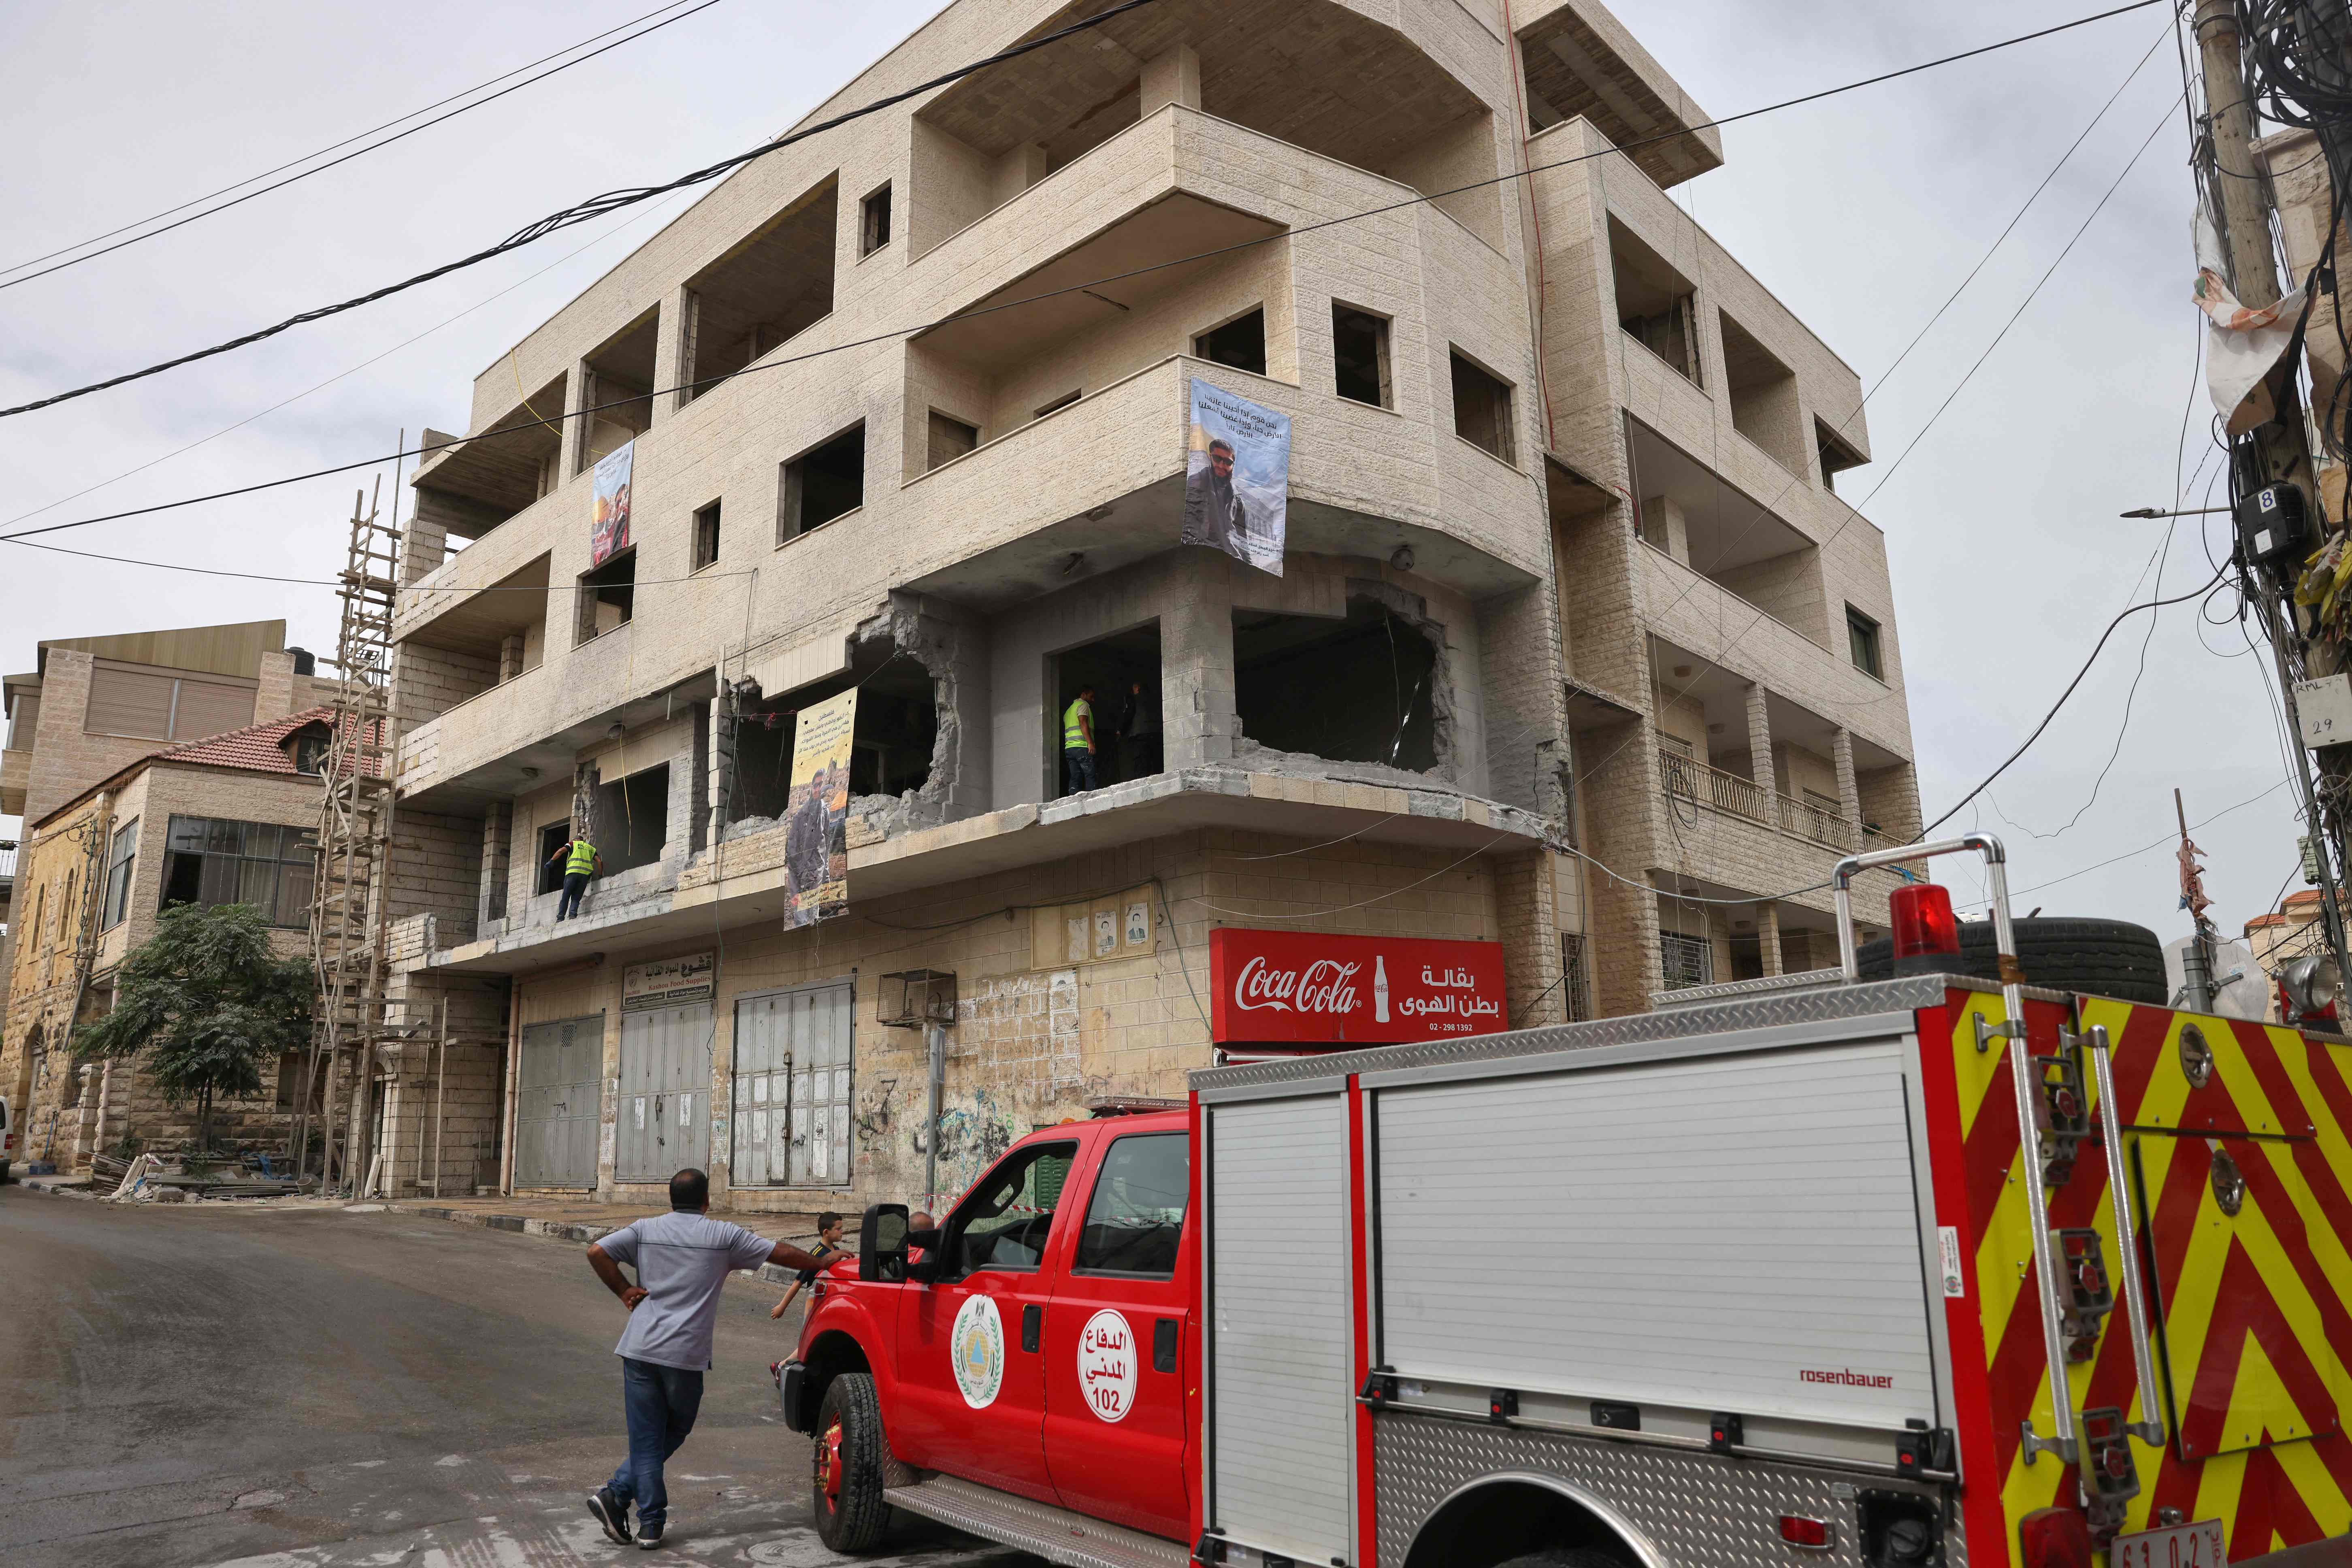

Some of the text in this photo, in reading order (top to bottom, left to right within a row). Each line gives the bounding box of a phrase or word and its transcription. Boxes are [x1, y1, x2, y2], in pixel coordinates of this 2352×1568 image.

[1205, 394, 1221, 406] عانقنا
[1224, 402, 1239, 413] أحببنا
[1221, 411, 1238, 422] غضبنا
[1239, 418, 1251, 429] وإذا
[1251, 415, 1265, 423] قوم
[1236, 429, 1253, 438] الأرض
[2262, 492, 2273, 508] 8
[818, 709, 835, 721] فلسطين
[2313, 719, 2332, 735] 29
[686, 976, 711, 985] Supplies
[1421, 965, 1474, 992] بقالة
[1399, 995, 1499, 1018] بطن الهوى
[1086, 1328, 1127, 1353] الدفاع
[1086, 1357, 1126, 1385] المدني
[1800, 1368, 1893, 1388] rosenbauer
[1093, 1387, 1120, 1412] 102
